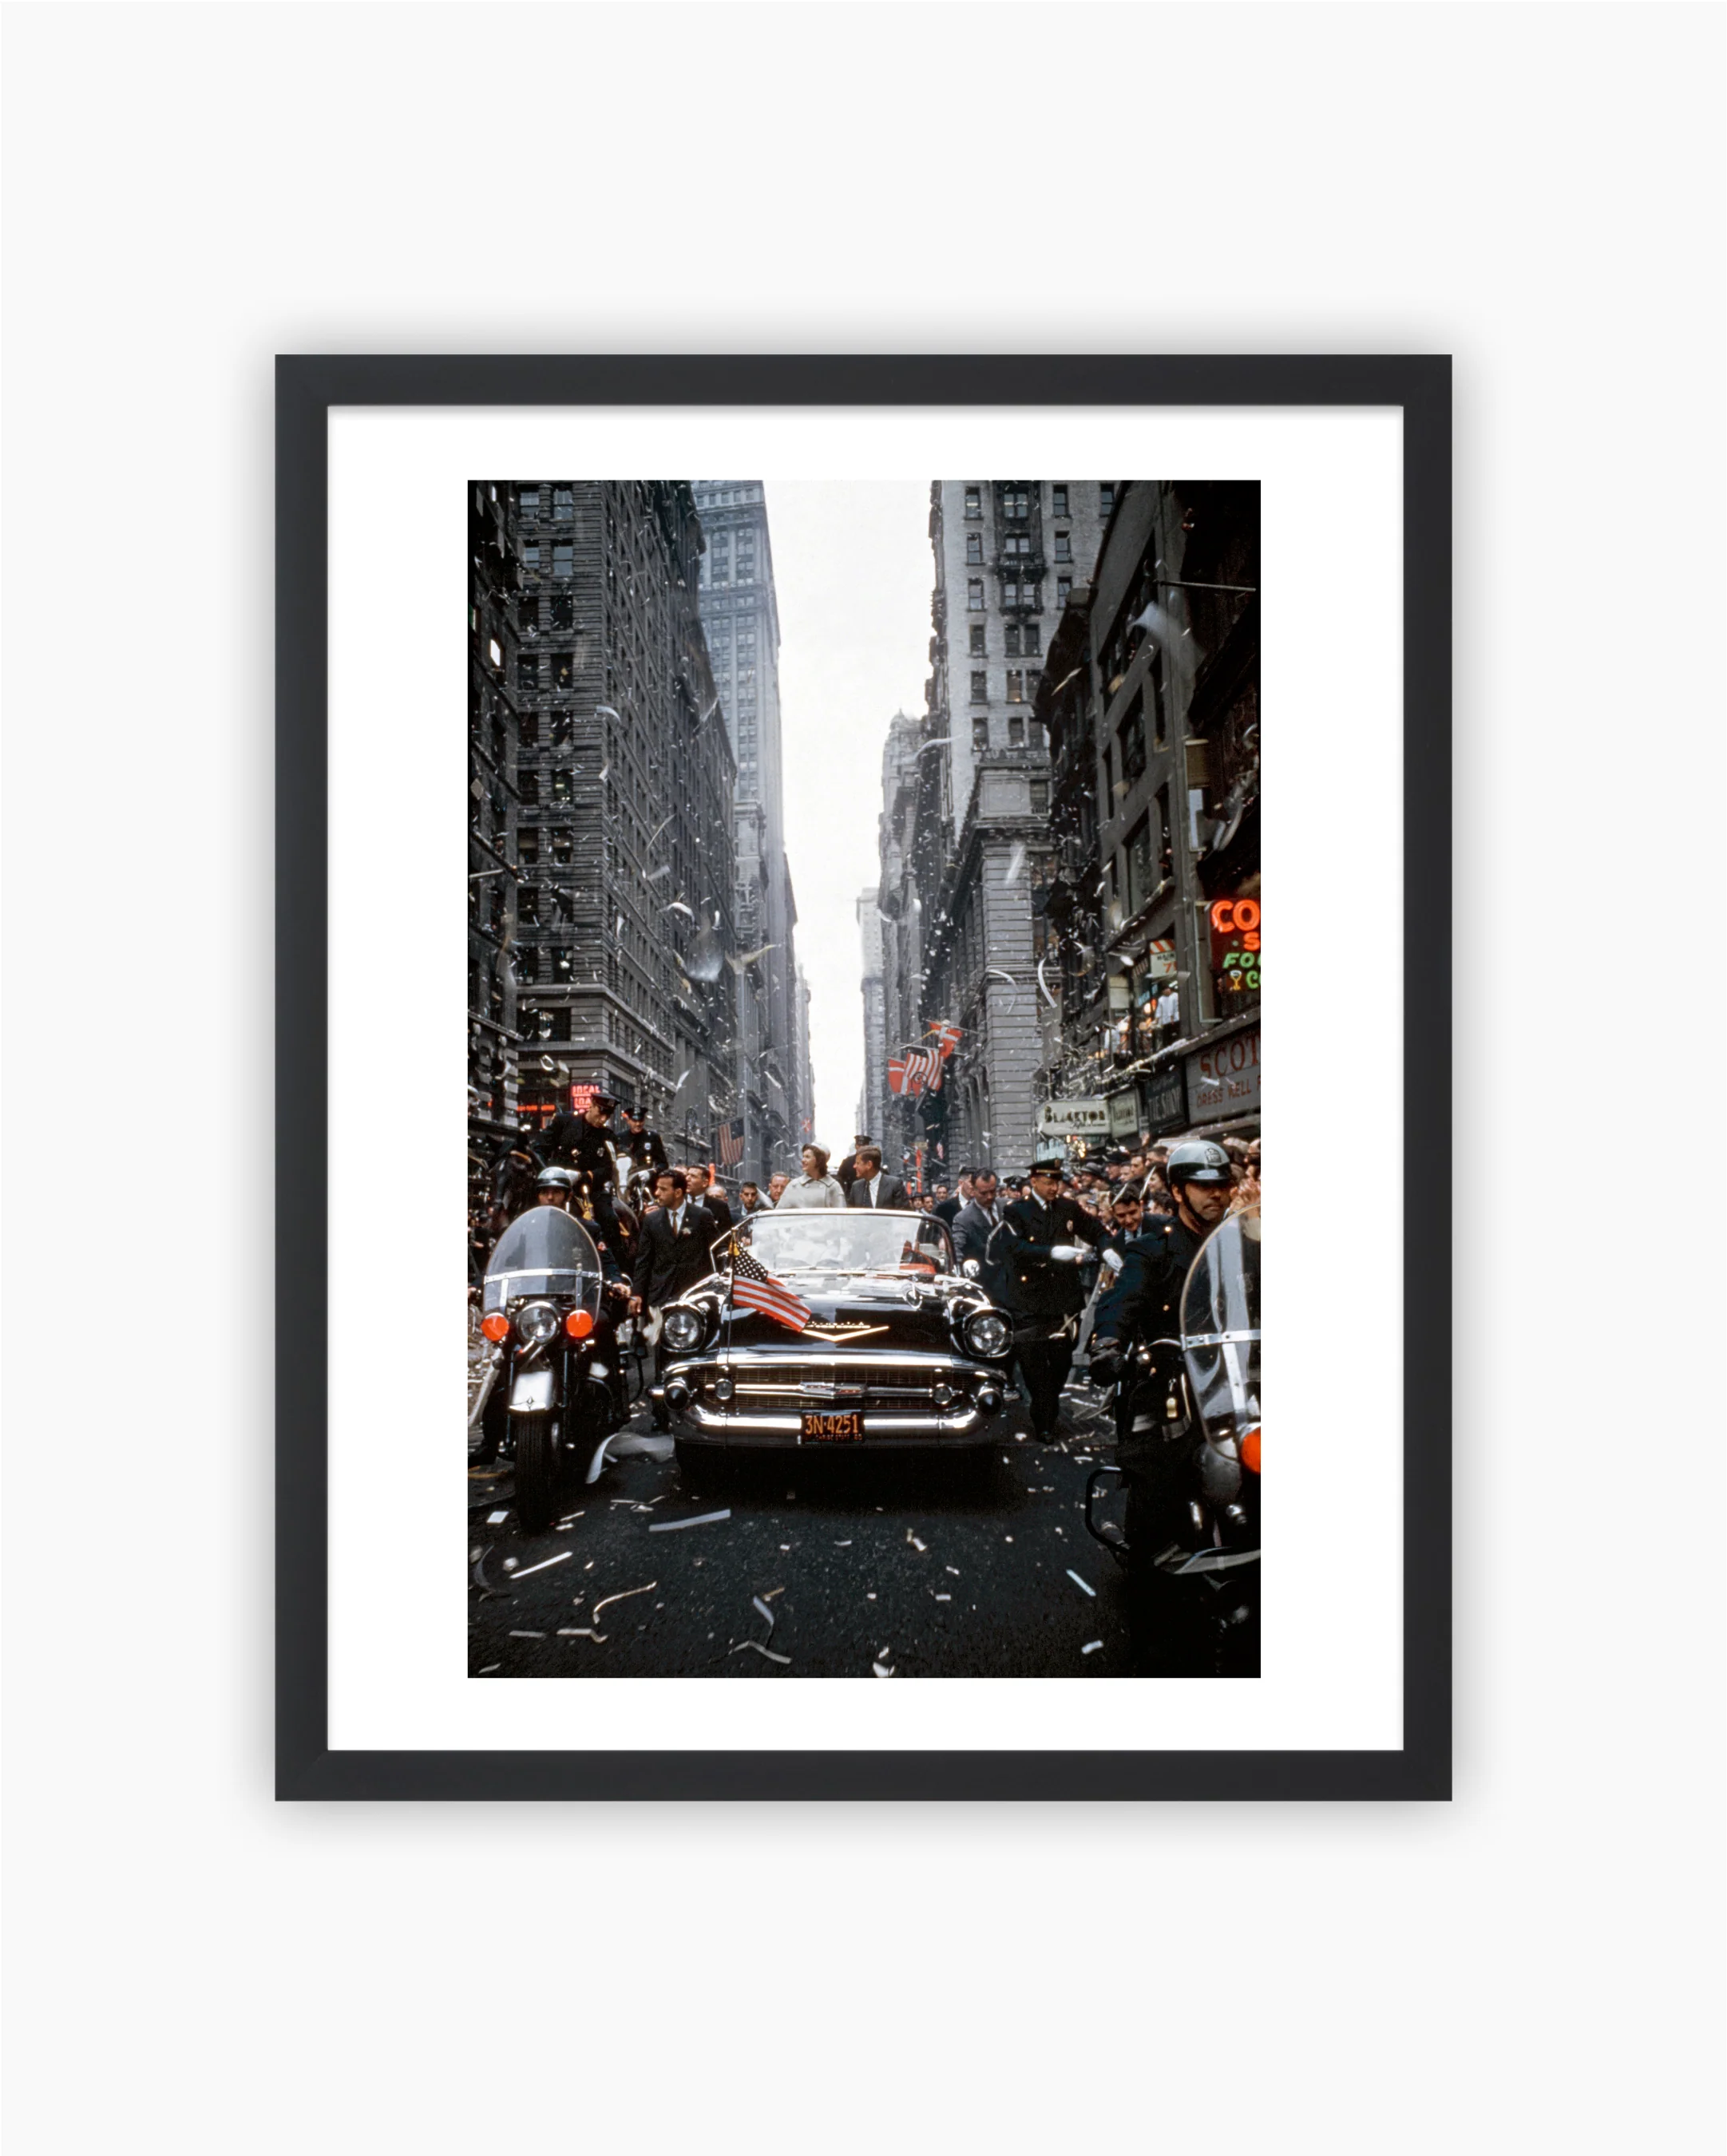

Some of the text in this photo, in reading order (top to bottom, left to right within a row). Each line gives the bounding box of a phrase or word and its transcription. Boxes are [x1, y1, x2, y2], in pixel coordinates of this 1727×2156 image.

[1222, 952, 1261, 969] FO
[1246, 970, 1261, 989] C
[1200, 1028, 1261, 1080] SCOT
[574, 1097, 592, 1110] LOA
